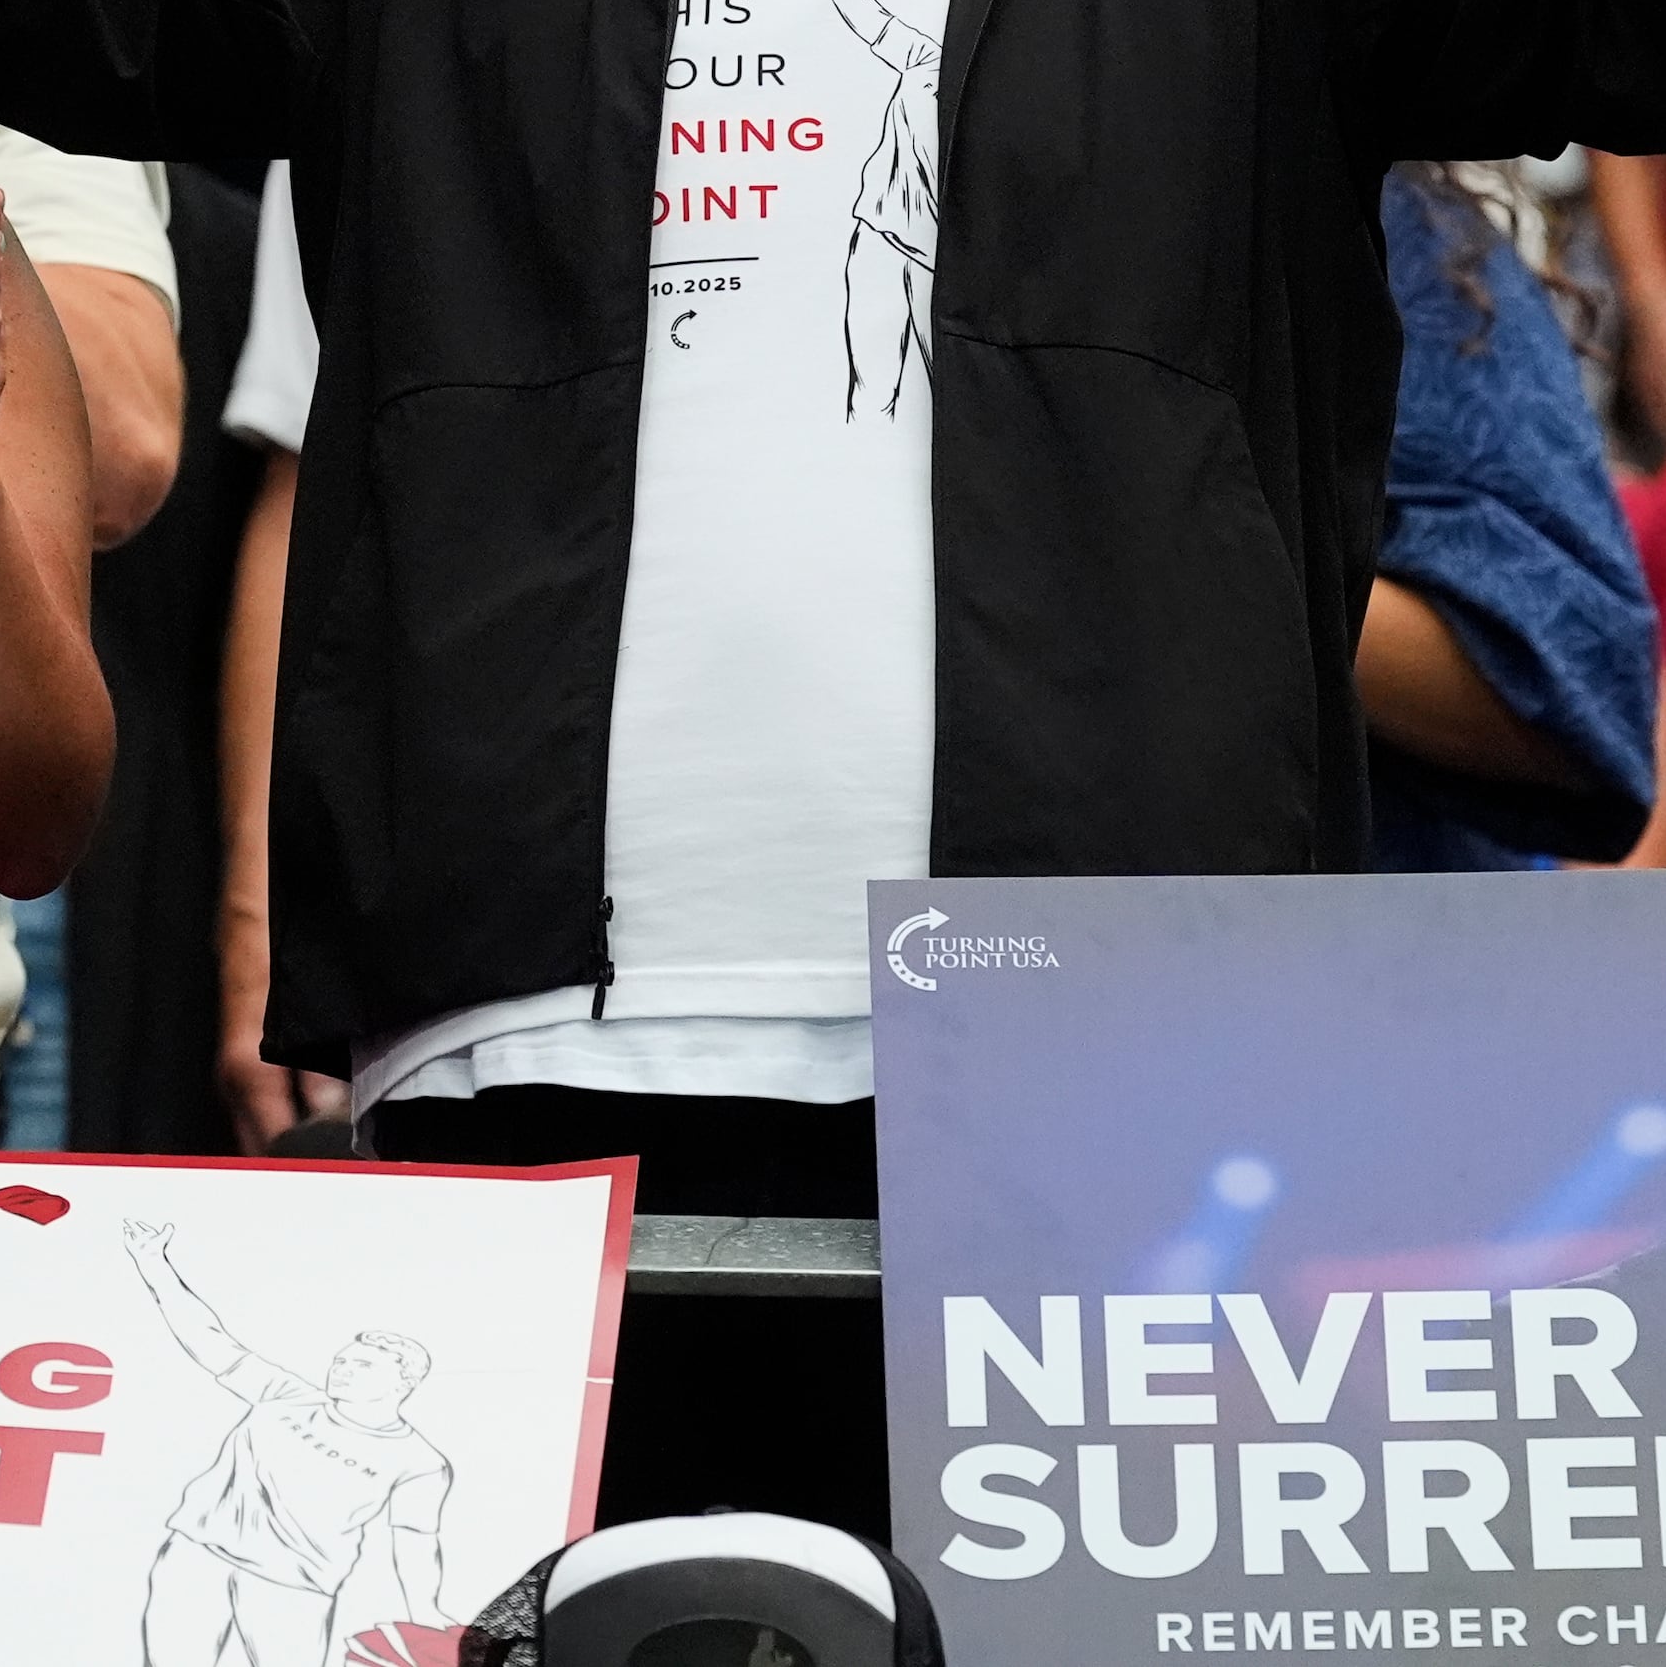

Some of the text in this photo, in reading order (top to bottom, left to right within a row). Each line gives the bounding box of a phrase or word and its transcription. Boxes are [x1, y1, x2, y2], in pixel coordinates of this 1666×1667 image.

[664, 53, 786, 90] OUR
[671, 117, 824, 155] NING
[652, 185, 779, 227] OINT
[649, 276, 742, 297] 10.2025
[922, 936, 1046, 953] TURNING
[925, 952, 1061, 969] POINT USA
[940, 1288, 1643, 1429] NEVER
[1155, 1606, 1530, 1653] REMEMBER
